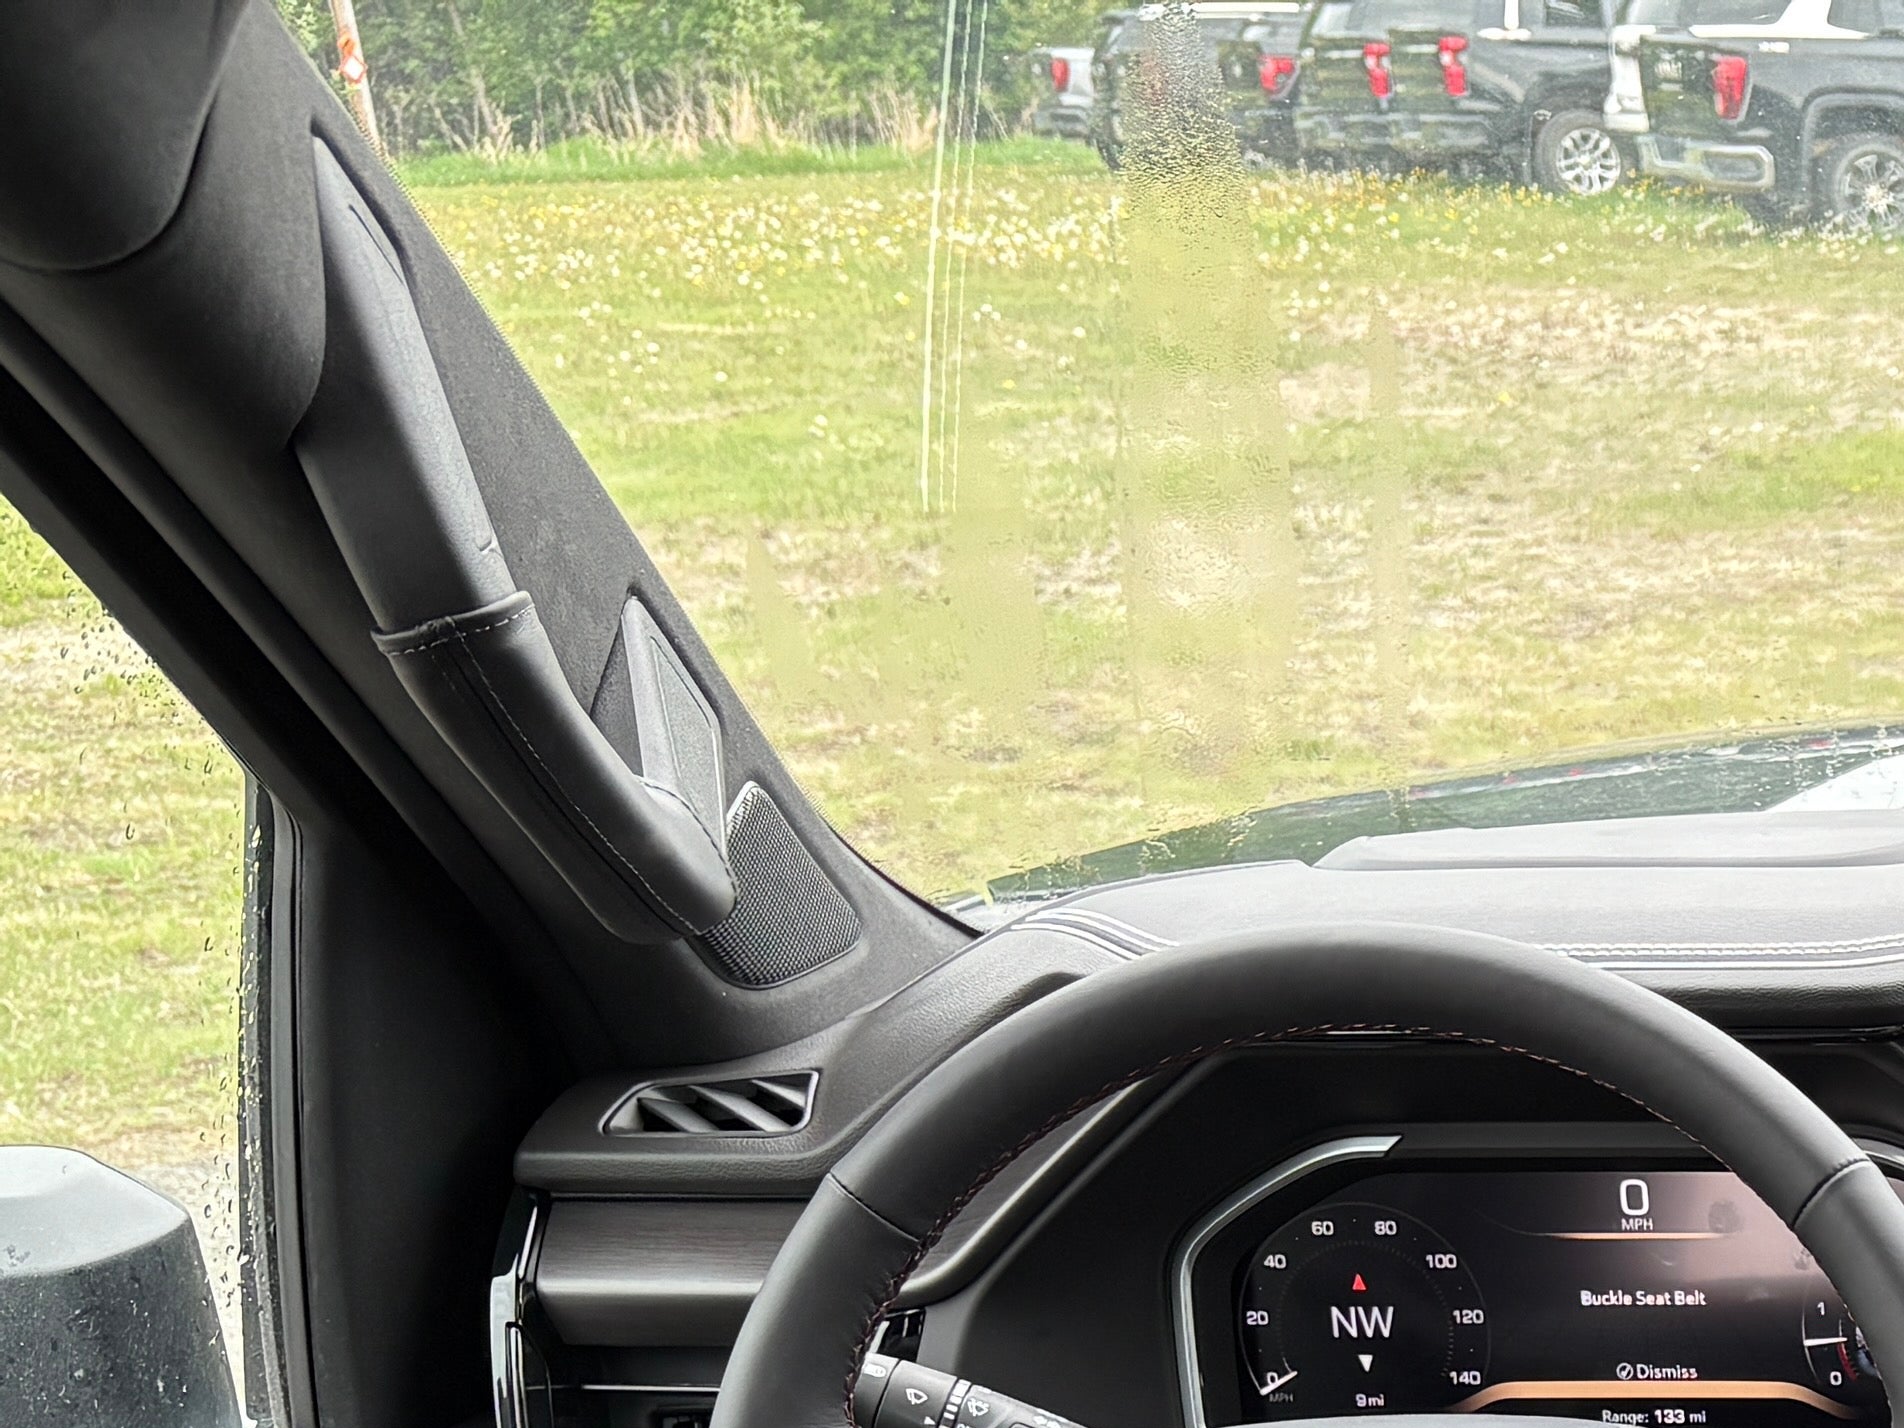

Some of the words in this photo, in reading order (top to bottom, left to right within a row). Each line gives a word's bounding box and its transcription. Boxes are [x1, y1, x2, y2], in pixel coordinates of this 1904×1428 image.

[1619, 1179, 1650, 1216] 0
[1311, 1221, 1334, 1236] 60
[1374, 1221, 1397, 1236] 80
[1621, 1218, 1653, 1231] MPH
[1263, 1254, 1287, 1269] 40
[1425, 1254, 1457, 1269] 100
[1580, 1290, 1632, 1306] Buckle
[1635, 1290, 1672, 1306] Seat
[1674, 1290, 1706, 1306] Belt
[1816, 1302, 1826, 1316] 1
[1246, 1311, 1269, 1325] 20
[1330, 1306, 1394, 1338] NW
[1453, 1310, 1485, 1324] 120
[1449, 1370, 1481, 1385] 140
[1636, 1364, 1698, 1379] Dismiss
[1830, 1371, 1842, 1386] 0
[1269, 1393, 1294, 1402] MPH
[1602, 1410, 1650, 1425] Range:
[1654, 1409, 1685, 1424] 133
[1689, 1410, 1706, 1423] mi
